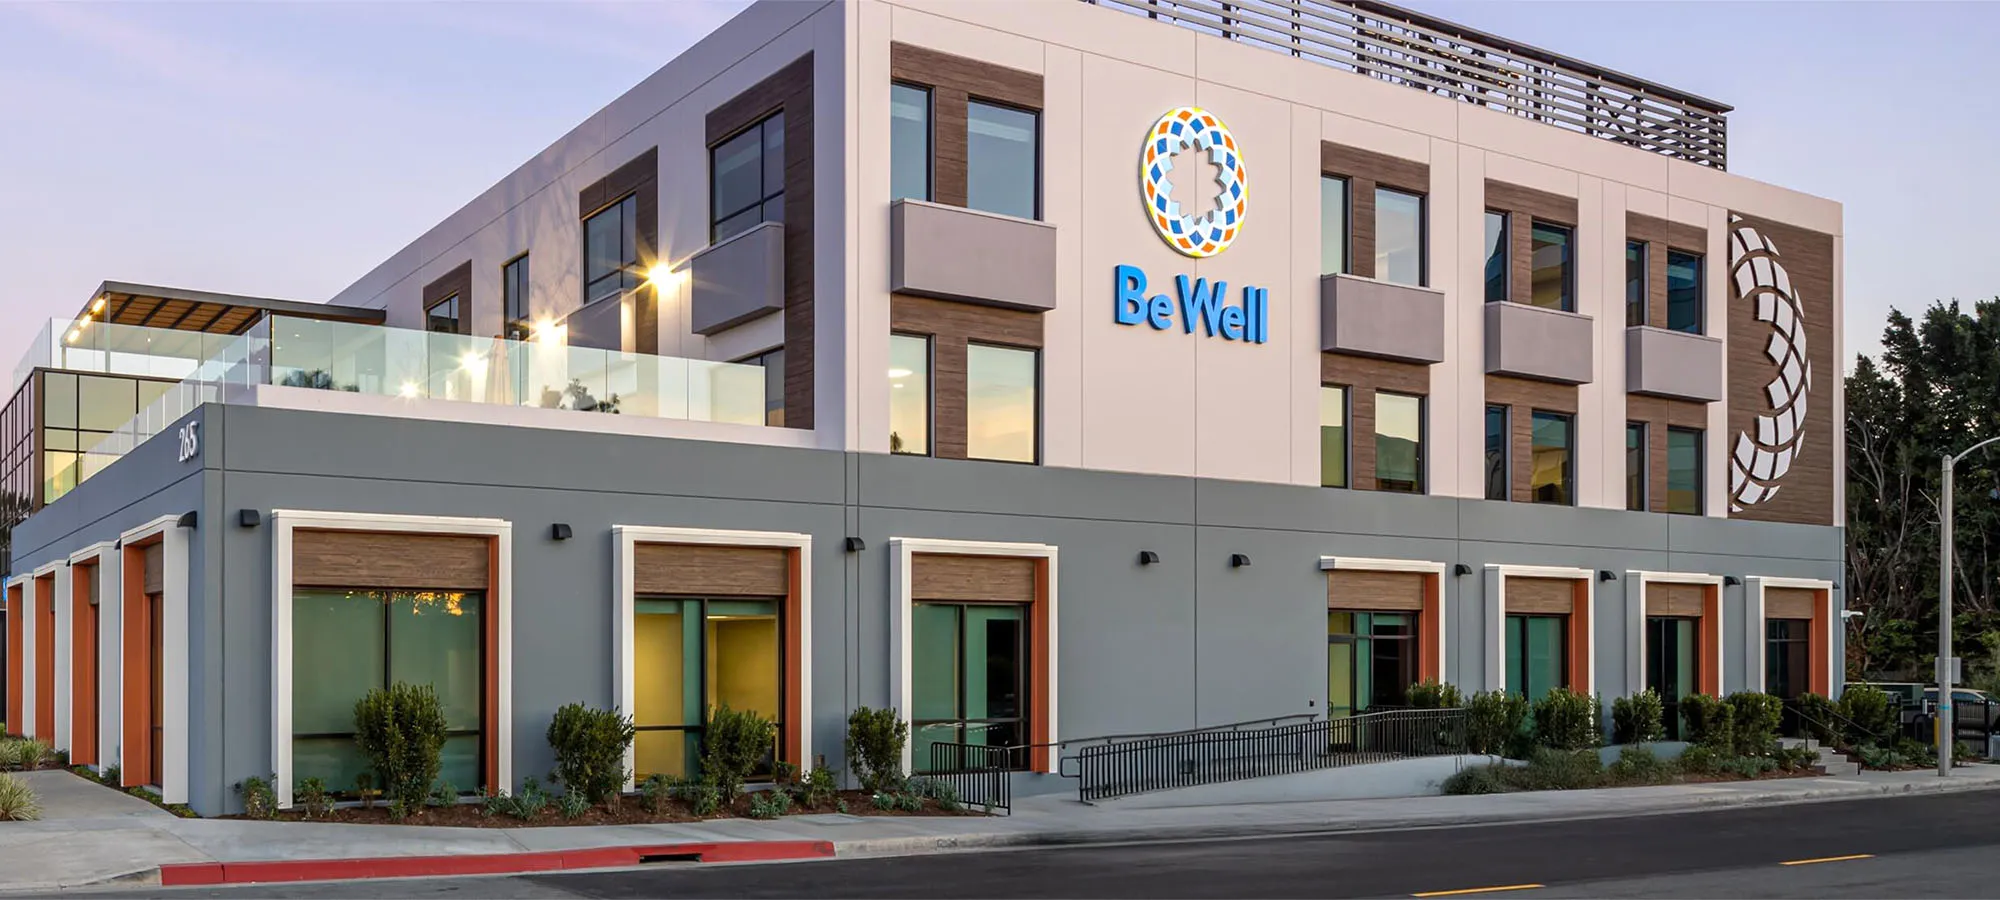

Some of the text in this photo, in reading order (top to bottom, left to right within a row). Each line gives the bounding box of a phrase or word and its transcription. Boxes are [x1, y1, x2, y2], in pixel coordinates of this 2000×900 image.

[1115, 264, 1268, 344] Be Well
[178, 420, 198, 462] 265
